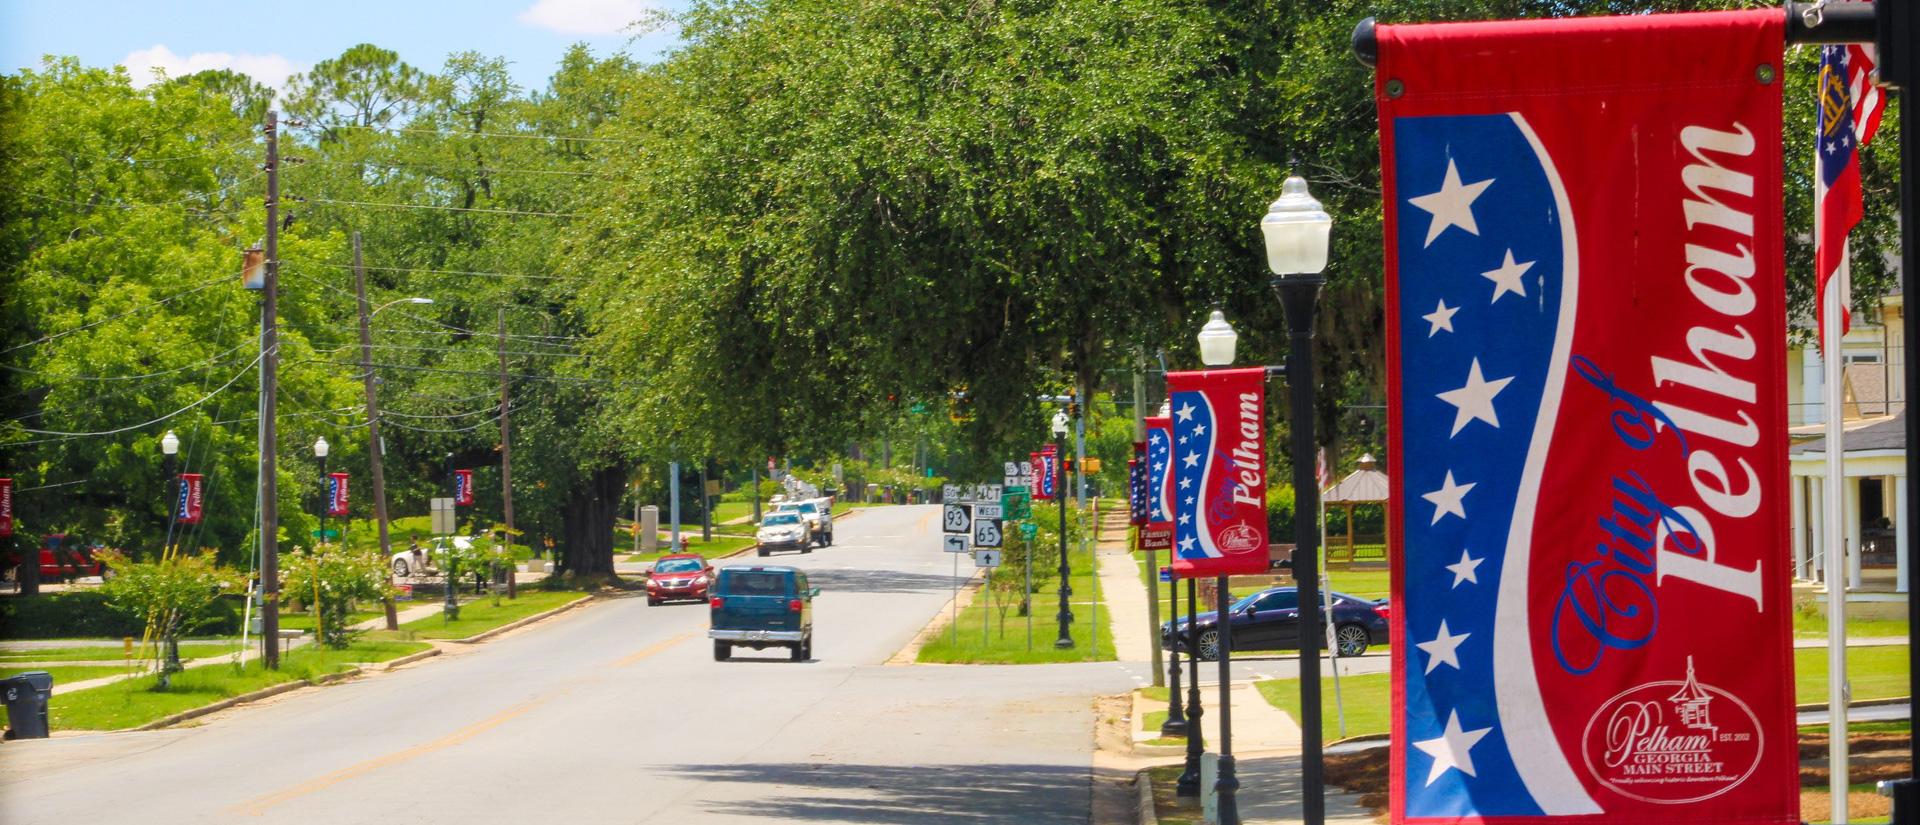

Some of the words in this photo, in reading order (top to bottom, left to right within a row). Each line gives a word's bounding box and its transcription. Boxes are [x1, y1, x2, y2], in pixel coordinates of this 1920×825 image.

[1651, 121, 1764, 614] Pelham
[1571, 354, 1688, 459] of
[1233, 392, 1262, 509] Pelham
[1006, 464, 1015, 473] 65
[1021, 464, 1031, 473] 93
[1, 485, 10, 518] Pelham
[192, 480, 201, 507] Pelham
[978, 487, 1000, 500] JCT
[947, 510, 963, 526] 93
[978, 506, 1000, 516] WEST
[978, 526, 995, 543] 65
[1144, 538, 1170, 547] Bank
[1551, 470, 1701, 675] City
[1604, 701, 1712, 768] Pelham
[1633, 752, 1712, 764] GEORGIA
[1623, 764, 1662, 775] MAIN
[1665, 762, 1724, 774] STREET
